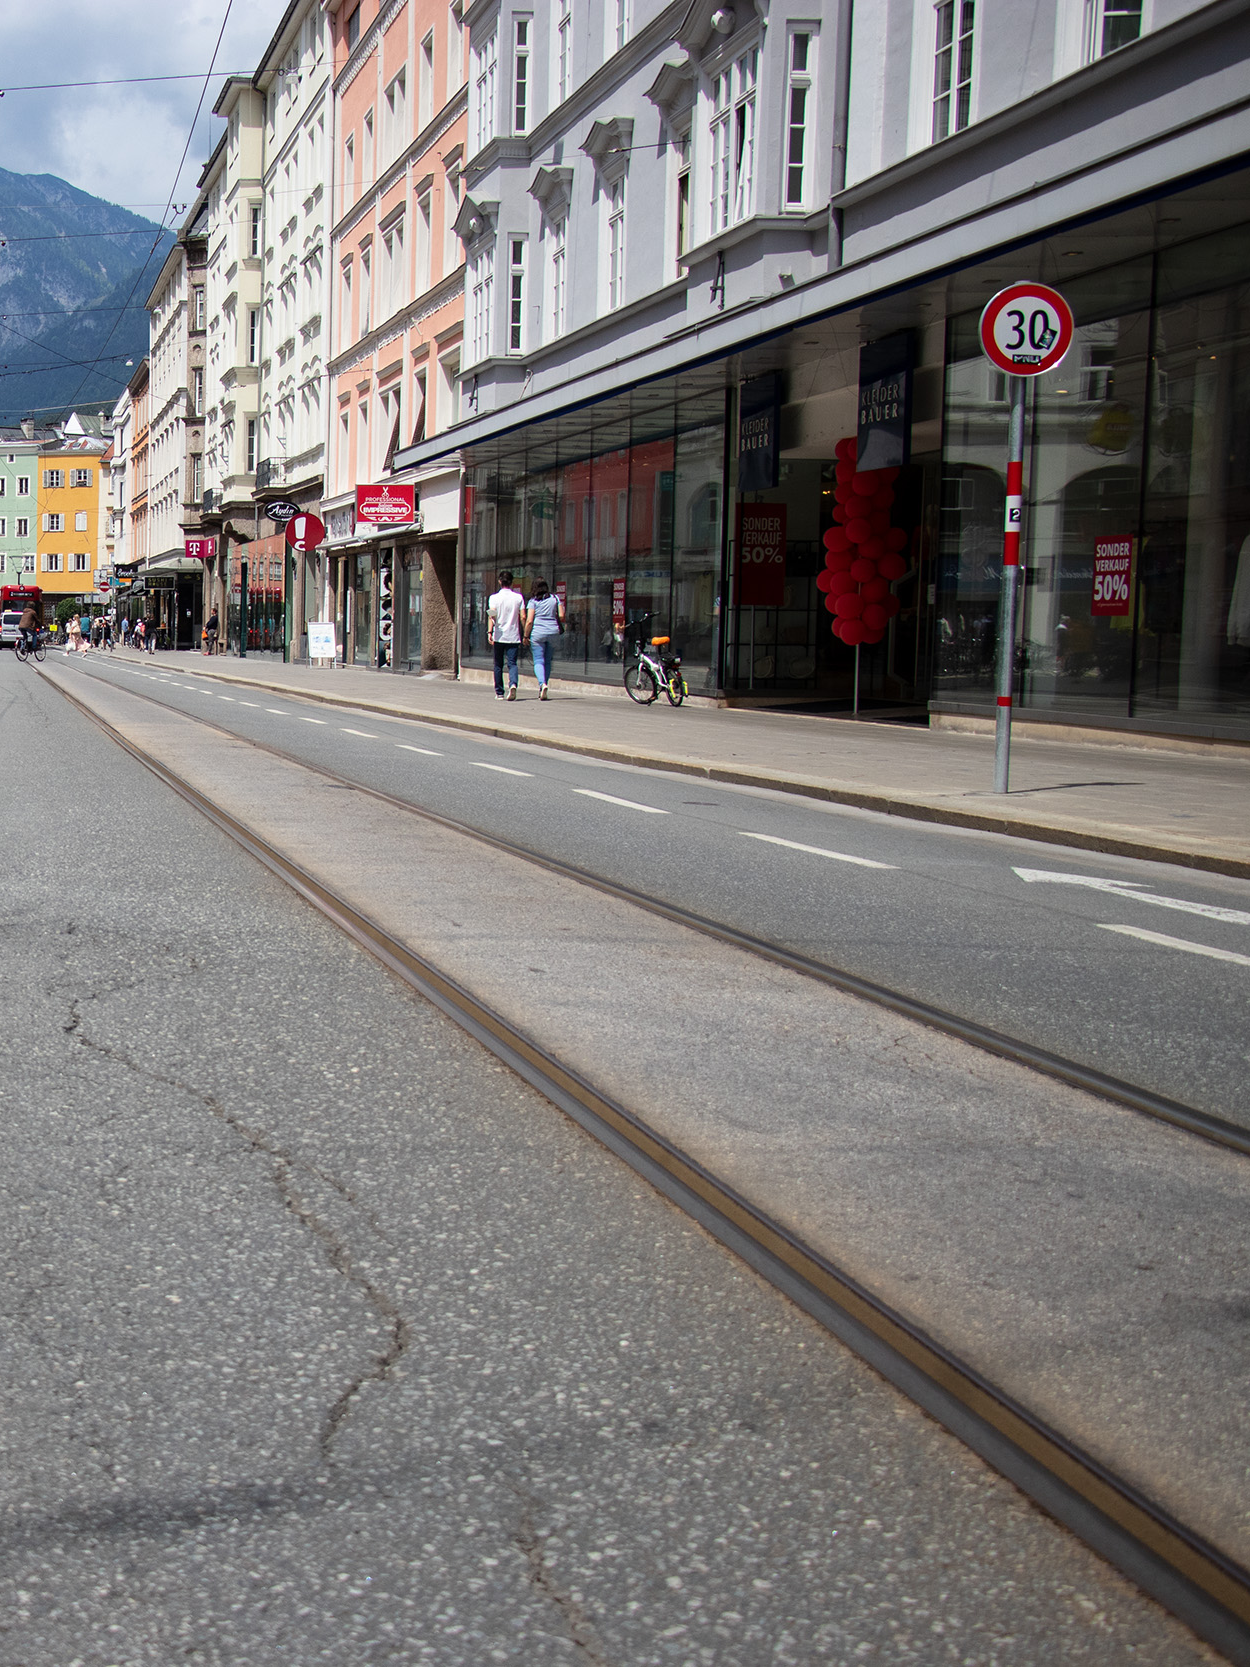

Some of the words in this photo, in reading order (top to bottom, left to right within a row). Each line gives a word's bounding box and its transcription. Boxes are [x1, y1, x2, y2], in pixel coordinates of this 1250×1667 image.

[1005, 309, 1050, 351] 30
[861, 384, 900, 406] KLEIDER
[861, 402, 899, 425] BAUER
[741, 417, 770, 436] KLEIDER
[741, 433, 769, 452] BAUER
[742, 517, 781, 531] SONDER
[1012, 509, 1021, 521] 2
[742, 546, 784, 564] 50%
[1096, 542, 1130, 558] SONDER
[1095, 558, 1129, 572] VERKAUF
[1094, 574, 1128, 601] 50%
[613, 600, 625, 615] 50%
